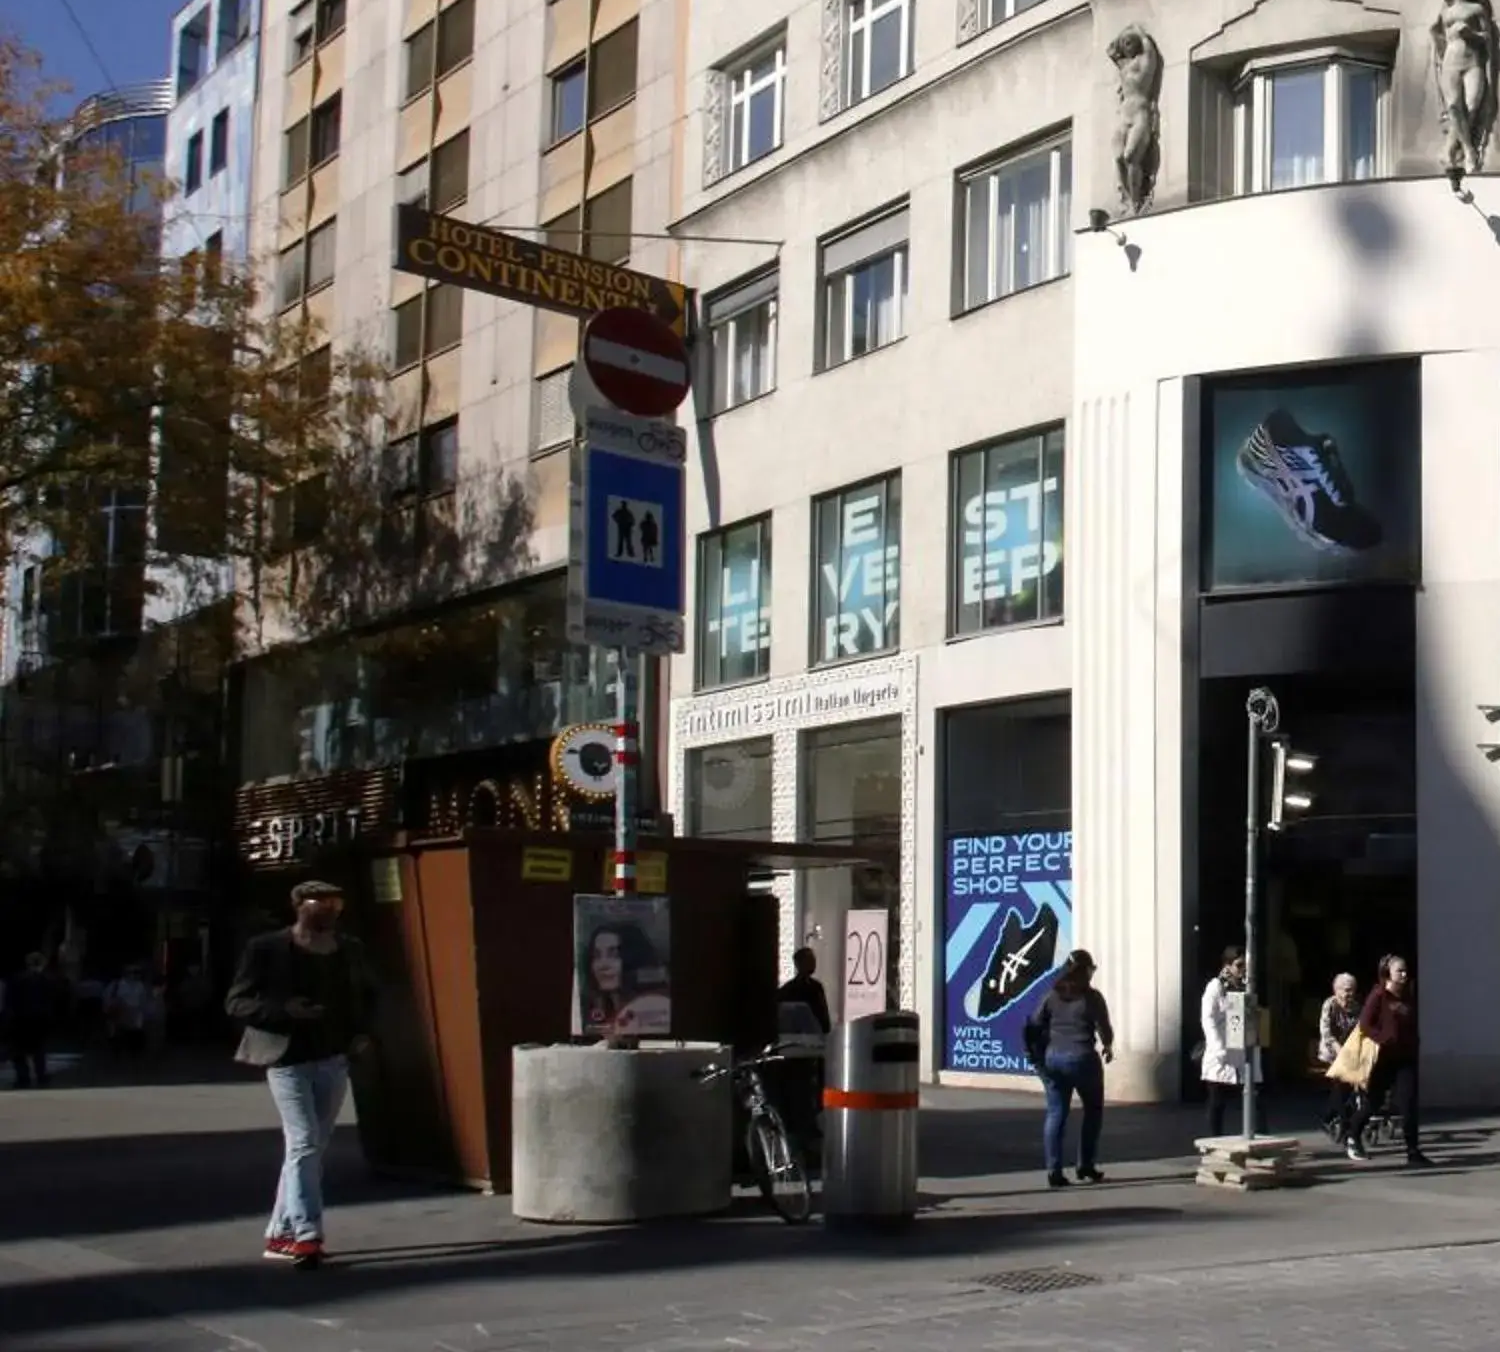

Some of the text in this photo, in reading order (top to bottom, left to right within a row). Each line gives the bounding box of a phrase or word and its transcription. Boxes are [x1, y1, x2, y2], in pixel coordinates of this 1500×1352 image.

[247, 804, 362, 860] ESPRIT
[953, 835, 1007, 857] FIND
[953, 874, 1019, 896] SHOE
[953, 1025, 992, 1039] WITH
[953, 1039, 1003, 1054] ASICS
[952, 1054, 1020, 1070] MOTION
